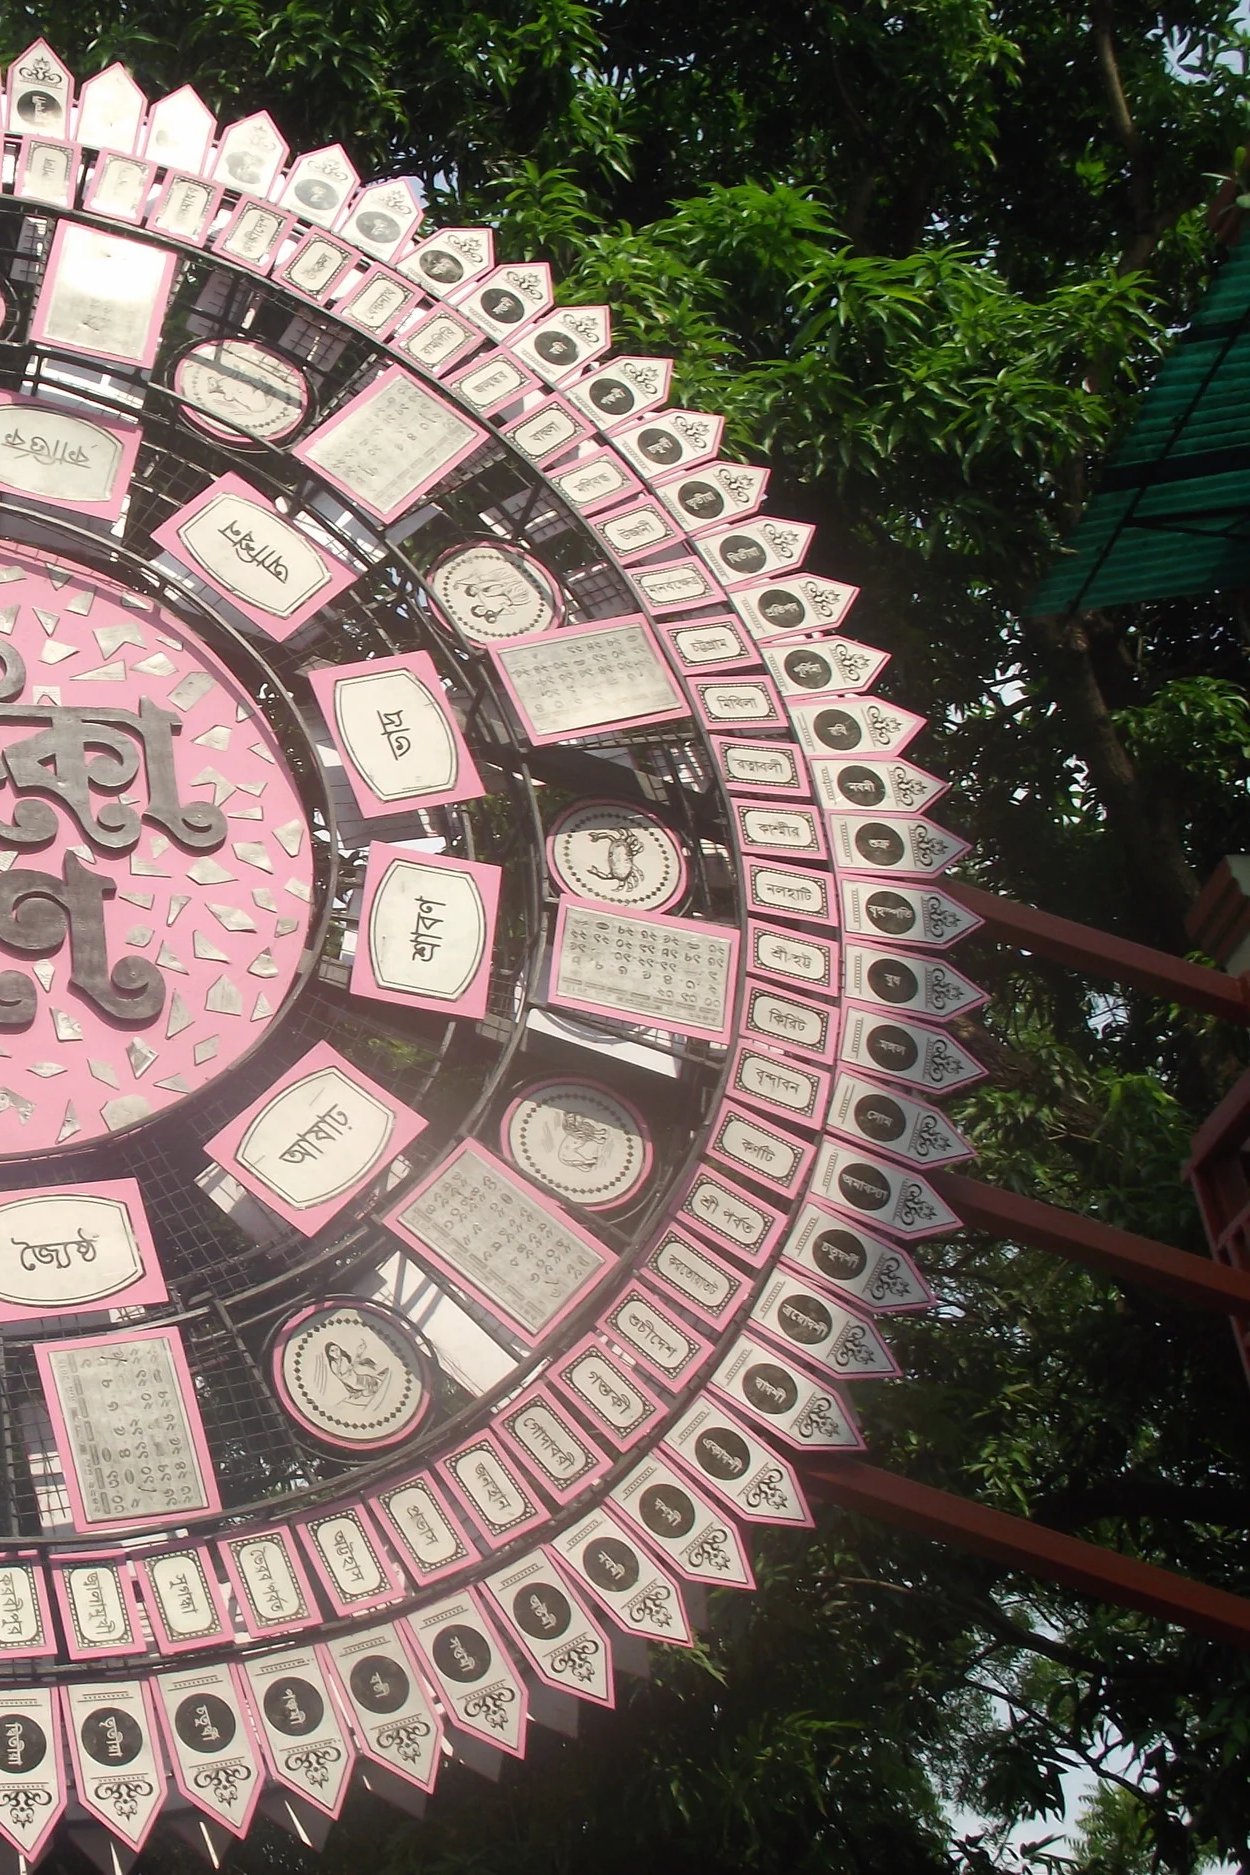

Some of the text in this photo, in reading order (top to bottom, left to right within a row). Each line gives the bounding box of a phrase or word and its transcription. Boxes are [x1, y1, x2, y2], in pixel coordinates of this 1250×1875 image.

[217, 520, 288, 583] আশ্বিন
[716, 695, 756, 708] মিথিলা
[376, 709, 410, 760] ভাদ্র
[765, 883, 811, 900] নলহাটি
[409, 895, 446, 961] শ্রাবণ
[884, 973, 900, 986] বুধ
[755, 1067, 800, 1093] বৃন্দাবন
[278, 1103, 351, 1163] আষাঢ়
[866, 1110, 892, 1126] সোম
[741, 1138, 775, 1161] কর্ণাট
[841, 1173, 887, 1197] অমাবস্যা
[700, 1194, 755, 1233] শ্রী পর্বত
[10, 1227, 98, 1271] জ্যৈষ্ঠ
[629, 1313, 677, 1357] শুচীদেশ
[782, 1303, 827, 1336] ত্রয়োদশী
[755, 1376, 785, 1402] দ্বাদশী
[523, 1417, 574, 1470] গোদাবরী
[702, 1438, 742, 1472] একাদশী
[406, 1505, 438, 1545] প্রভাস
[655, 1498, 681, 1525] দশমী
[334, 1530, 364, 1581] অট্টহাস
[598, 1550, 624, 1579] নবমী
[169, 1573, 198, 1613] সুগন্ধা
[249, 1546, 287, 1611] ভৈরব পর্বত
[83, 1571, 115, 1634] জ্বালামুখী
[530, 1594, 556, 1628] অষ্টমী
[450, 1636, 474, 1671] সপ্তমী
[370, 1672, 389, 1697] ষষ্ঠী
[194, 1705, 219, 1740] চতুর্থী
[282, 1688, 305, 1724] পঞ্চমী
[5, 1722, 24, 1765] দ্বিতীয়া
[98, 1716, 122, 1756] তৃতীয়া
